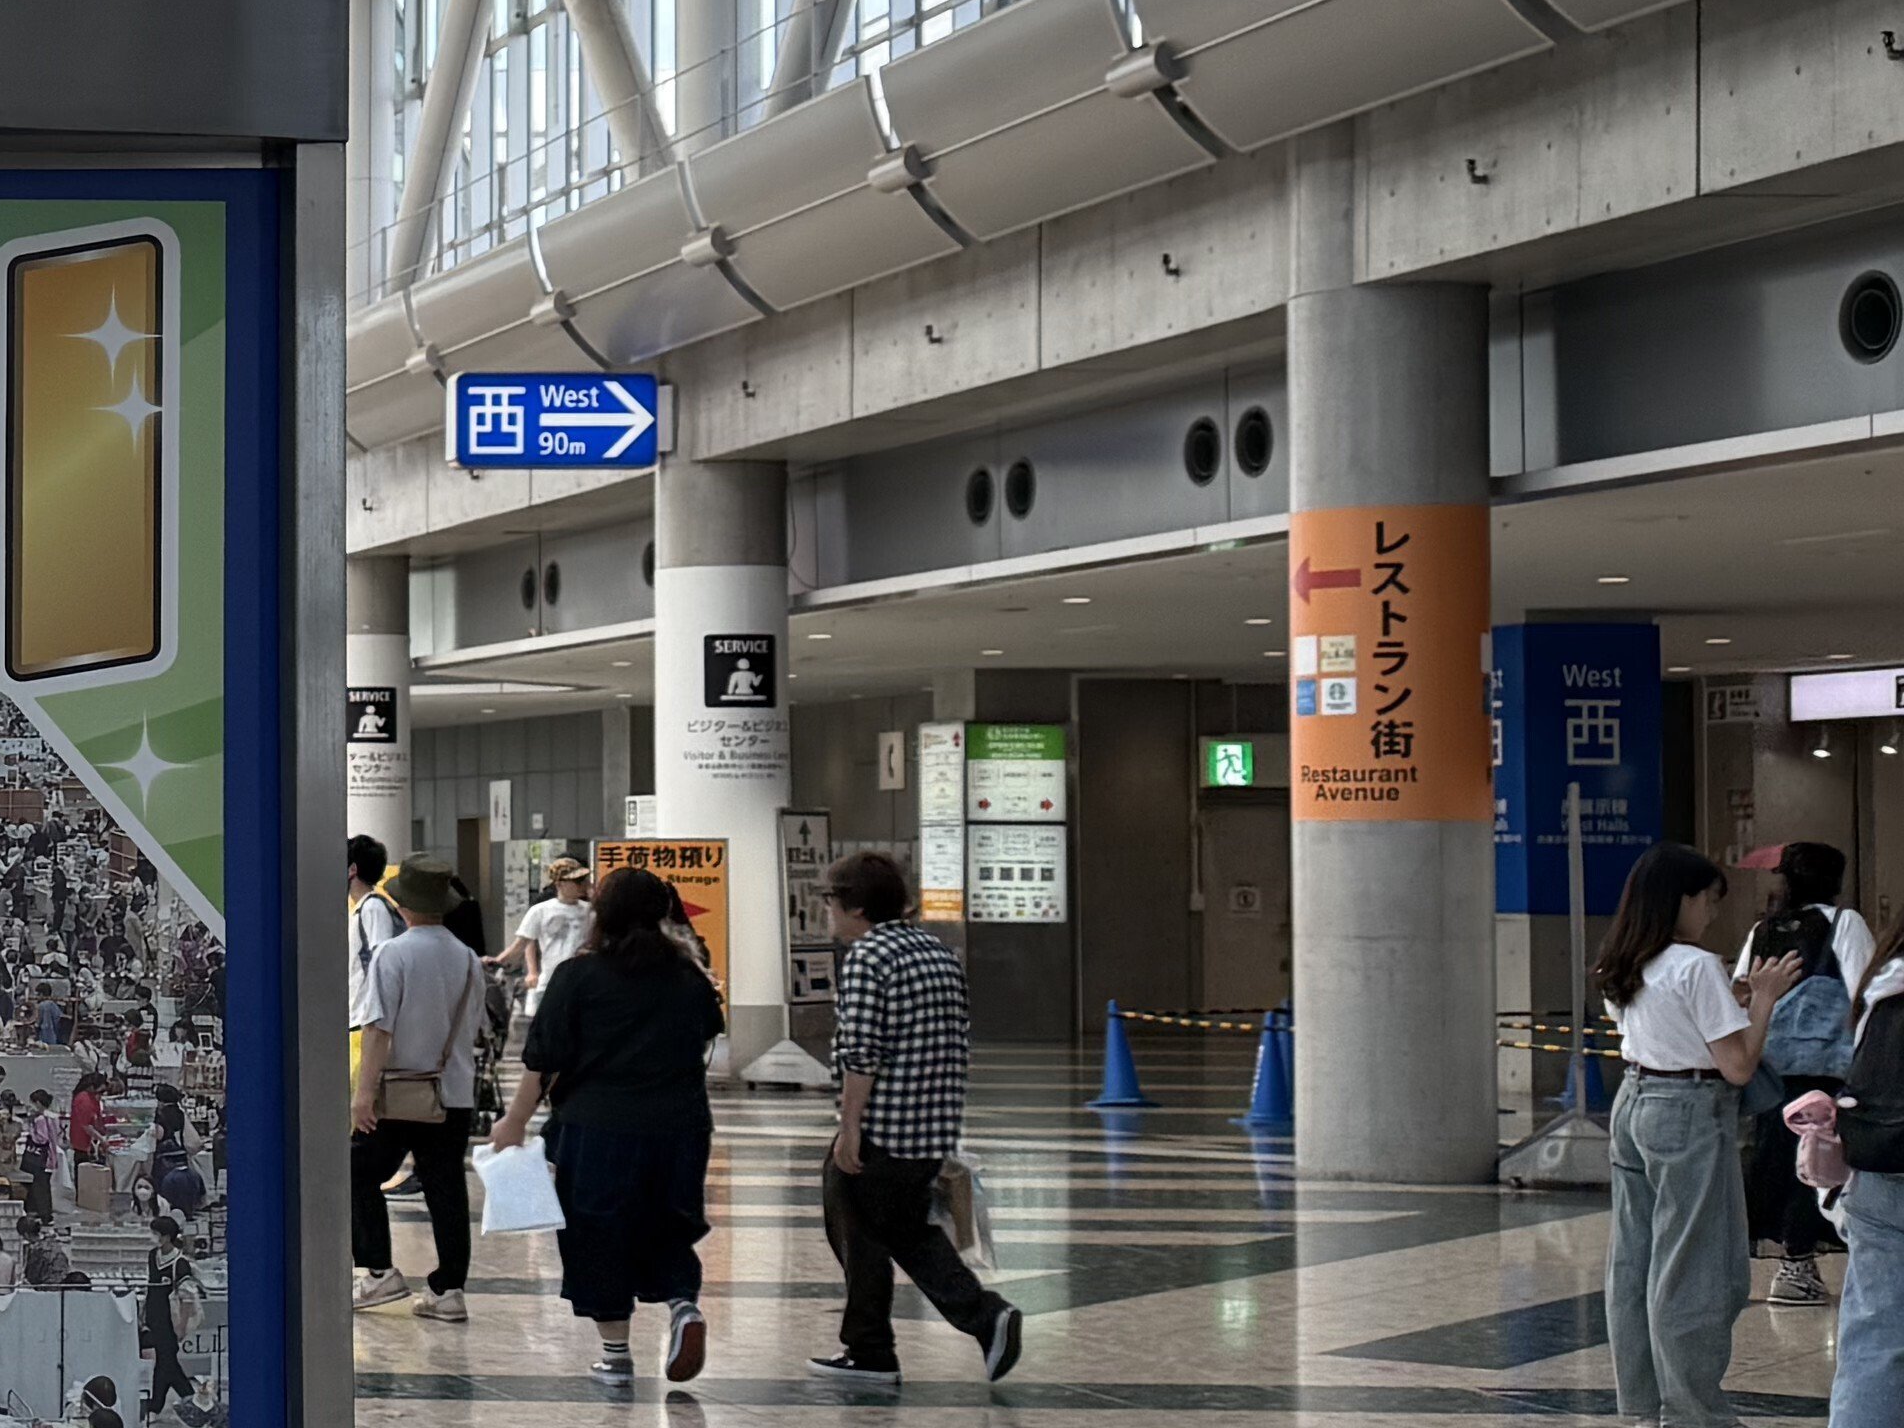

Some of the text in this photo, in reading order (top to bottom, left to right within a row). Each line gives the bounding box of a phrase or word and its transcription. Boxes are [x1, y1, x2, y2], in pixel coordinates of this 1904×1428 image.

[539, 384, 600, 408] West
[467, 386, 527, 455] 西
[538, 431, 586, 455] 90m
[714, 638, 769, 654] SERVICE
[1370, 521, 1414, 759] レストラン街
[1563, 664, 1622, 688] West
[349, 690, 391, 703] SERVICE
[1564, 699, 1621, 765] 西
[1301, 764, 1418, 783] Restaurant
[1315, 785, 1400, 802] Avenue
[598, 845, 724, 869] 手荷物預り
[667, 874, 720, 886] Storage
